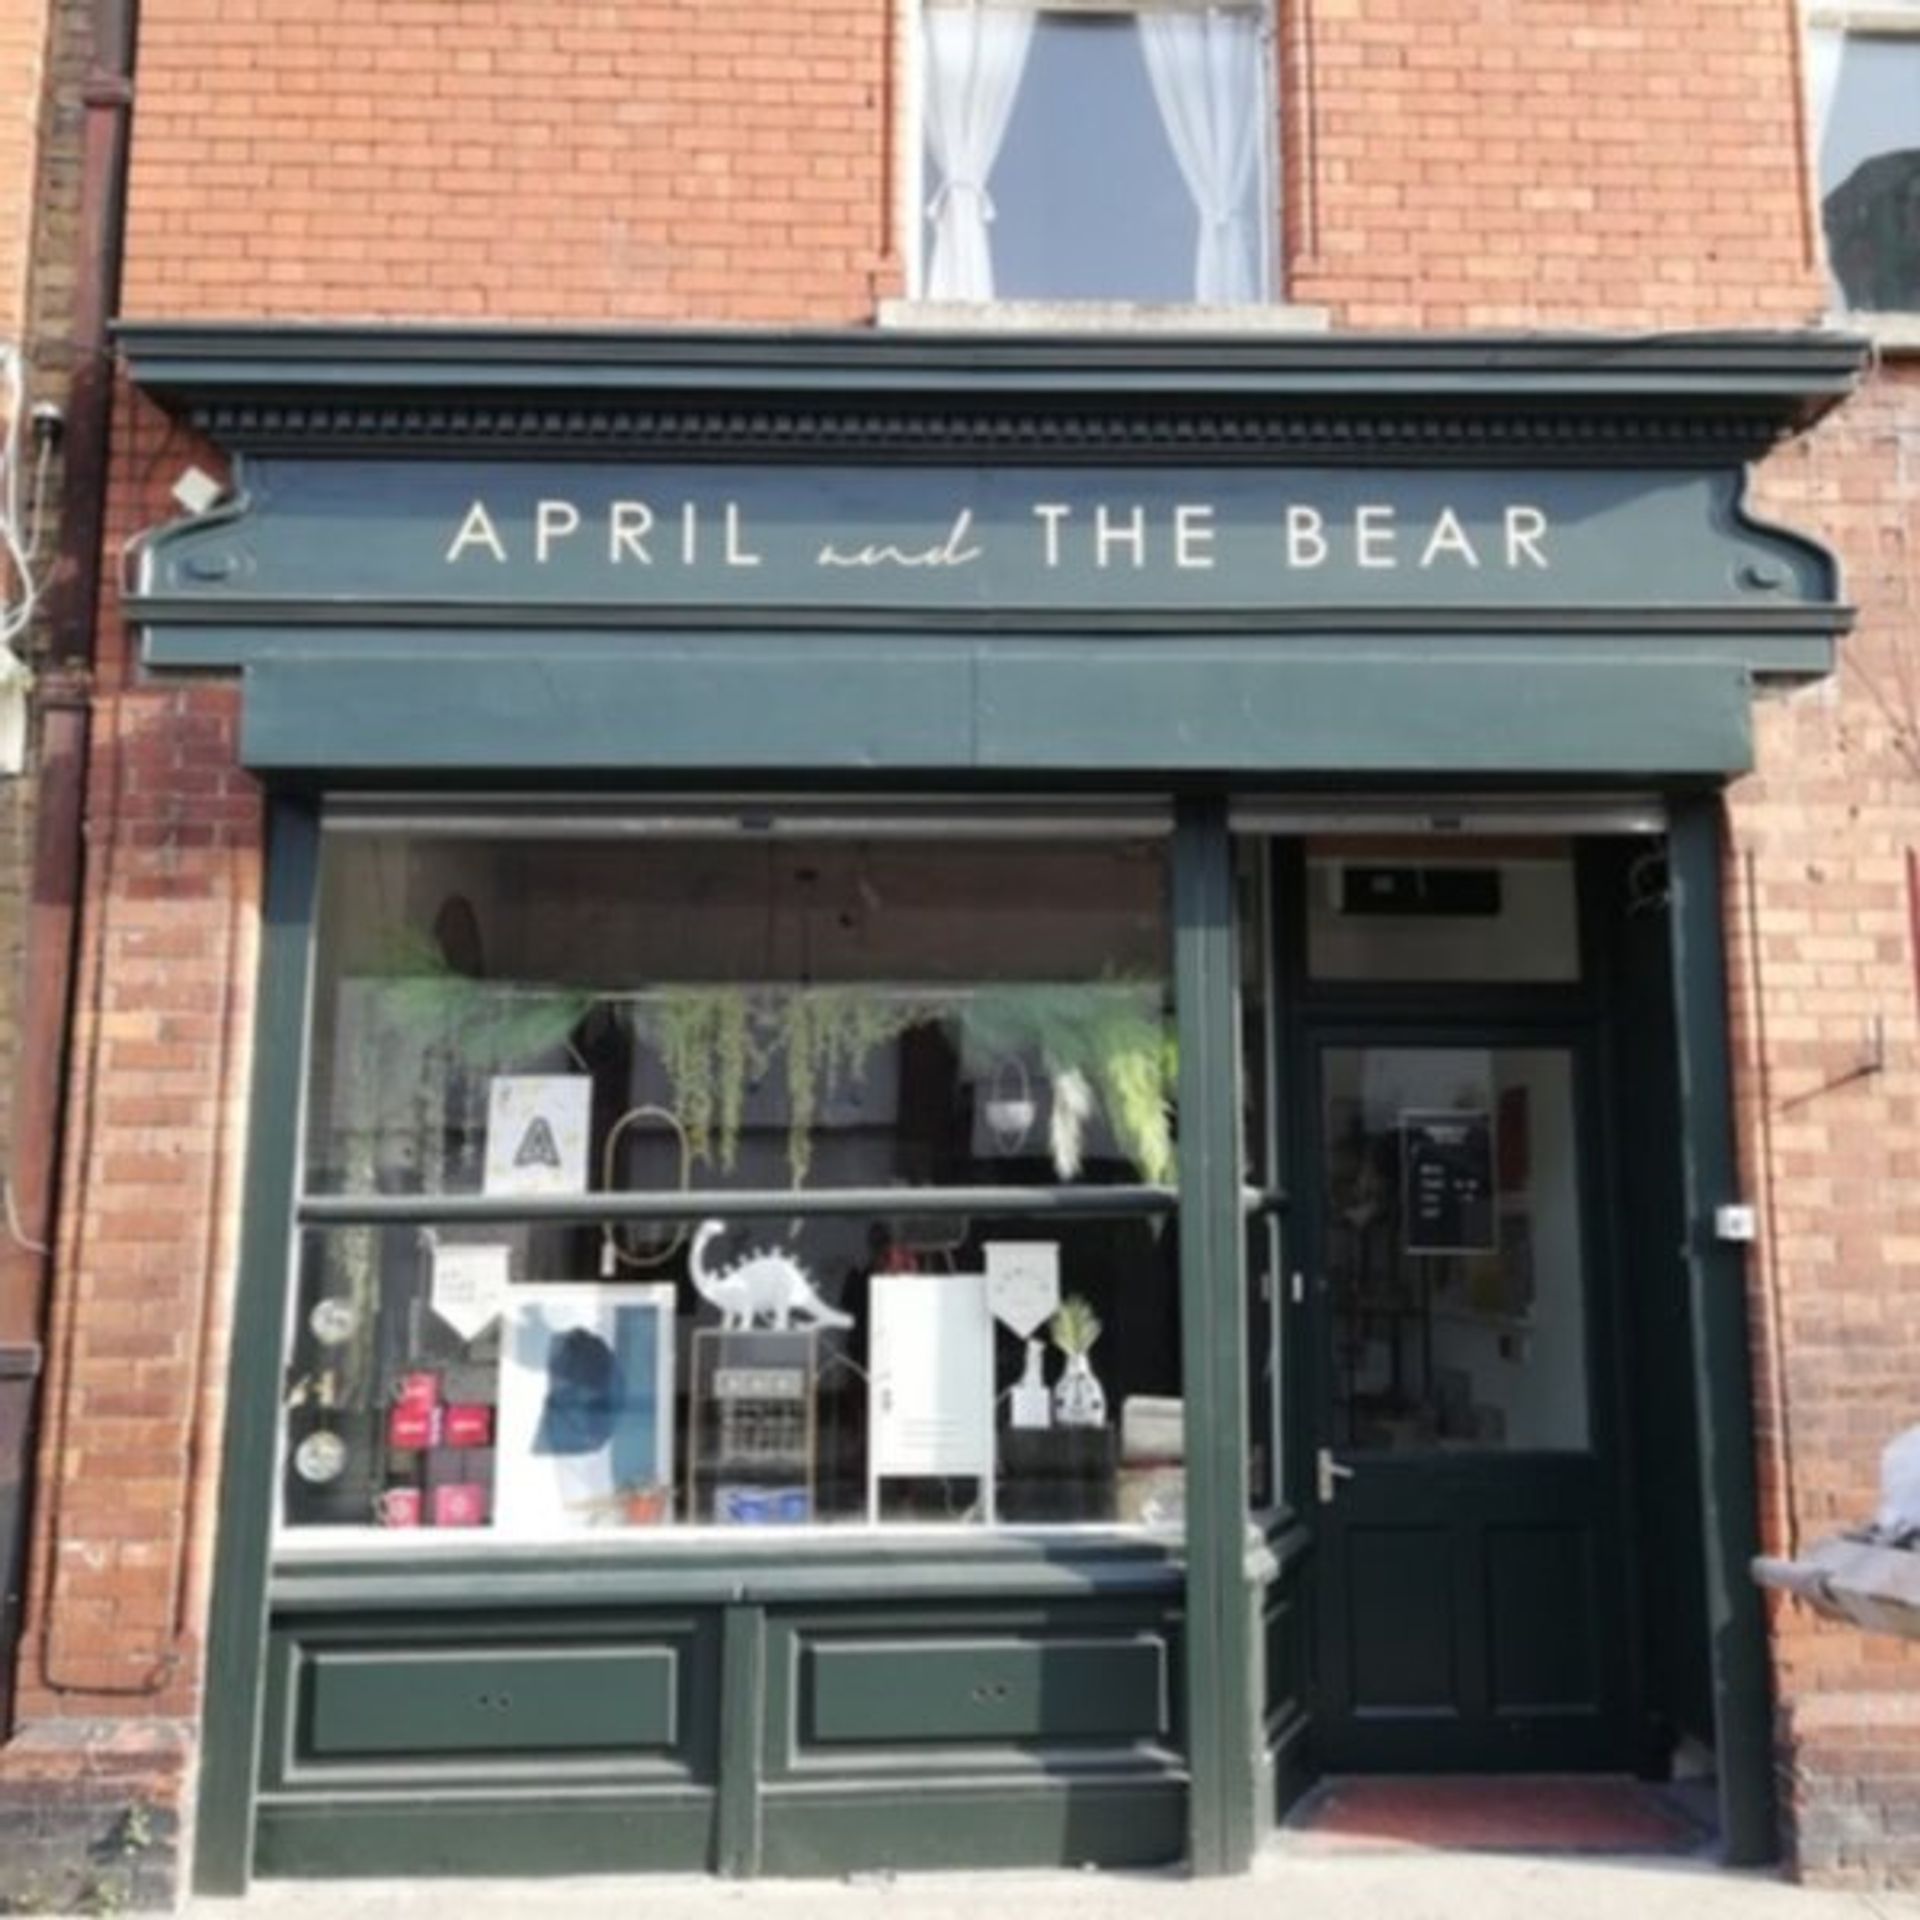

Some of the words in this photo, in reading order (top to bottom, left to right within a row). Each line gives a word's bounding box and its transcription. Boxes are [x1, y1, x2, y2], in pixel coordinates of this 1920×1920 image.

[446, 500, 760, 565] APRIL
[816, 508, 981, 566] and
[1034, 504, 1214, 567] THE
[1286, 506, 1548, 568] BEAR
[514, 1115, 561, 1167] A
